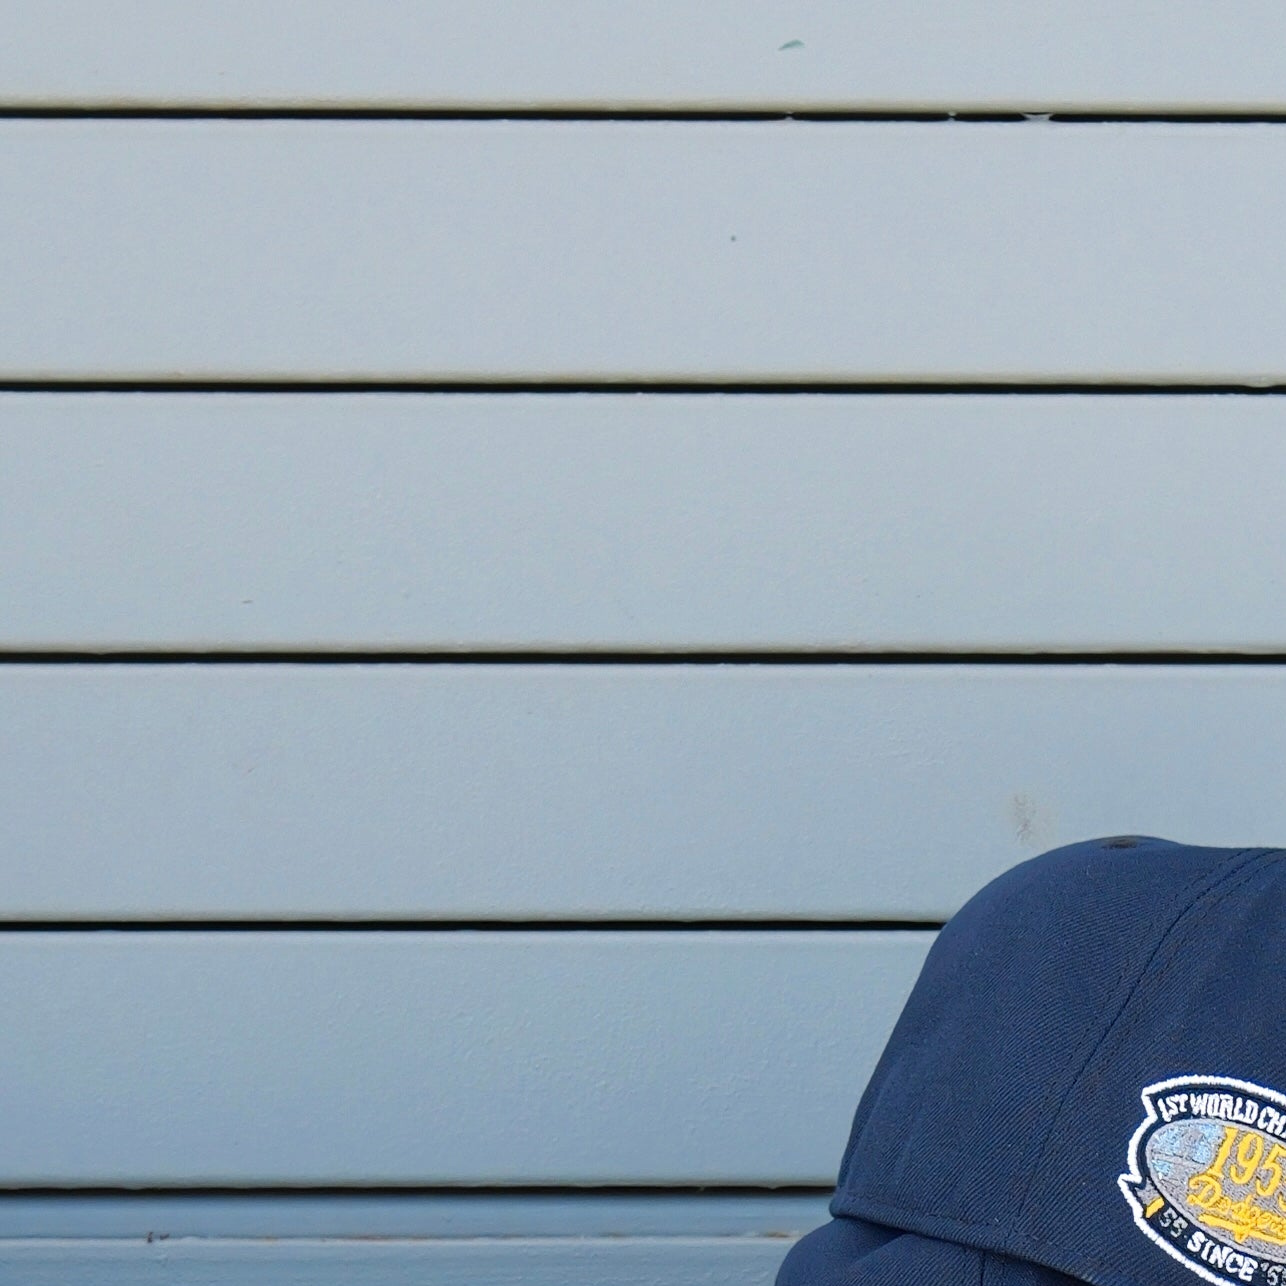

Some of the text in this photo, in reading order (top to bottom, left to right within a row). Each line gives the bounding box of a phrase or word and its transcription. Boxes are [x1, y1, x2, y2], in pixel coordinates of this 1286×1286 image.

[1158, 1095, 1188, 1122] 1ST
[1190, 1094, 1259, 1125] WORLD
[1187, 1231, 1258, 1282] SINCE
